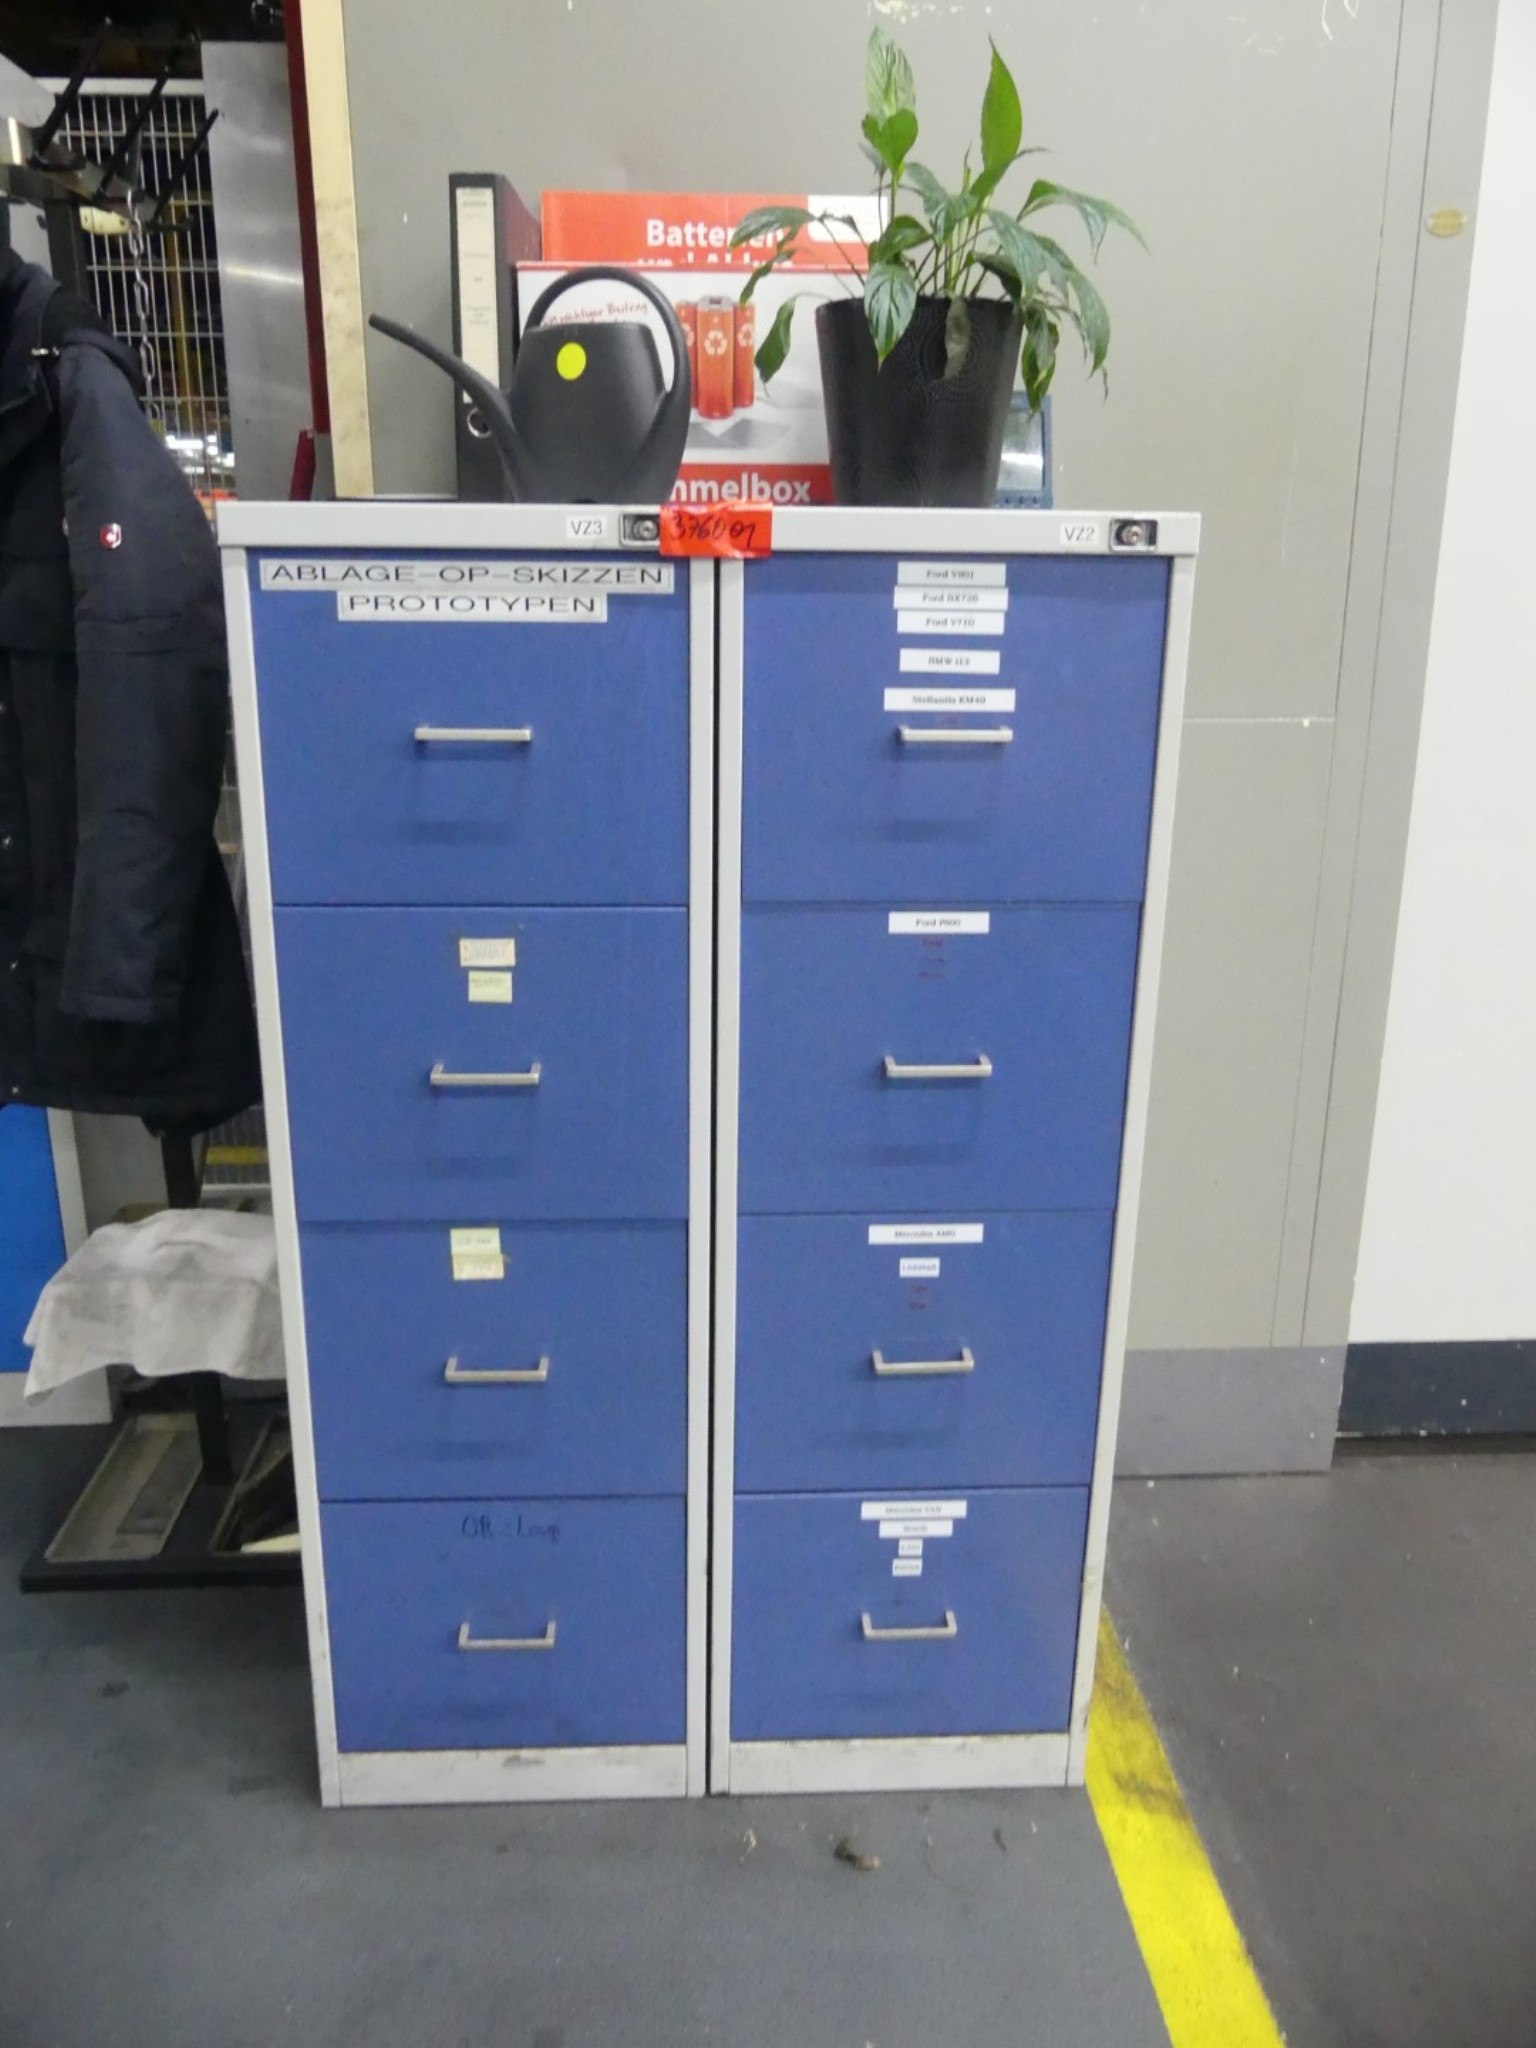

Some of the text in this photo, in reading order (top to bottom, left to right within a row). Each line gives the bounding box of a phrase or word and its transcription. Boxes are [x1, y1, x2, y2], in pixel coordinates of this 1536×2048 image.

[646, 218, 785, 249] Batteren
[570, 519, 603, 536] VZ3
[1064, 525, 1095, 542] VZ2
[271, 565, 664, 585] ABLAGE-OP-SKIZZEN
[926, 570, 949, 579] Ford
[349, 596, 595, 613] PROTOTYPEN
[922, 594, 944, 603] Ford
[926, 617, 948, 627] Ford
[915, 918, 937, 927] Ford
